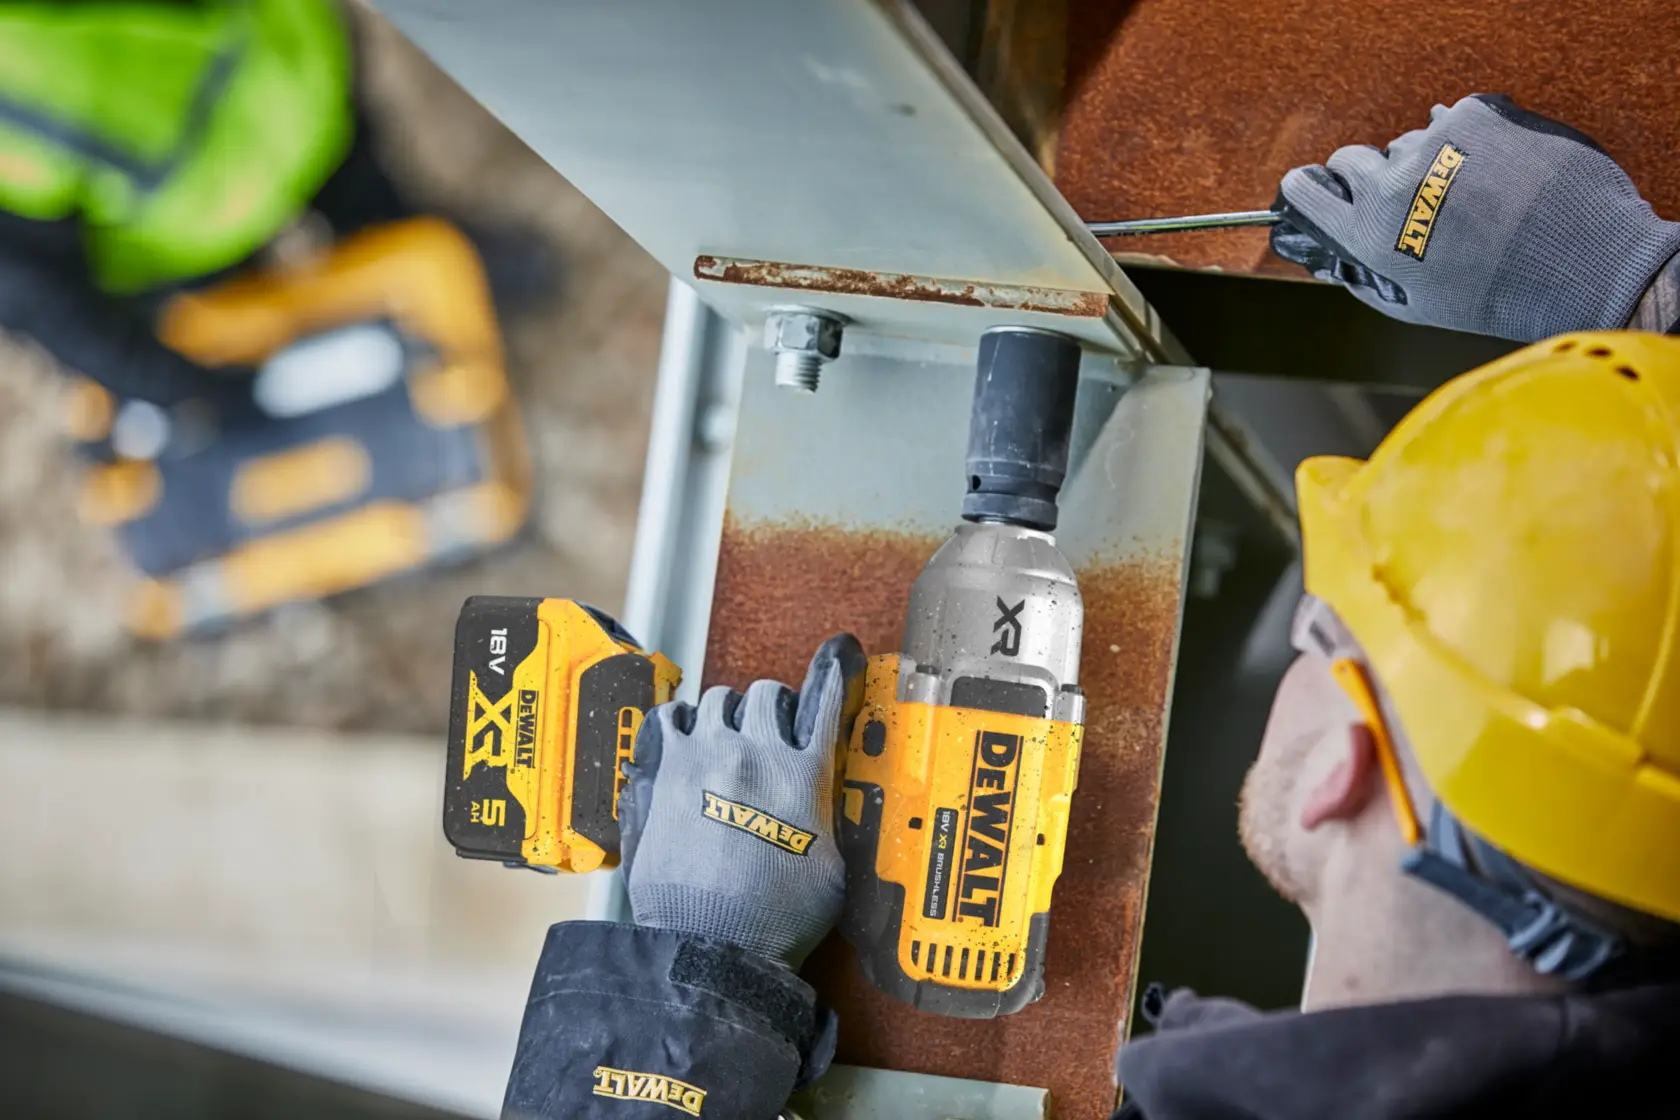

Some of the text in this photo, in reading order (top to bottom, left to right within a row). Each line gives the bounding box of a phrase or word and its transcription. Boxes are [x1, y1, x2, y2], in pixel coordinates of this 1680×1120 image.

[488, 628, 508, 675] 18V
[991, 595, 1025, 656] XR
[463, 669, 514, 781] XR
[515, 690, 538, 768] DEWALT
[482, 799, 506, 827] 5
[705, 796, 813, 852] DEWALT
[959, 730, 1019, 928] DEWALT
[930, 811, 951, 917] 18V XR BRUSHLESS
